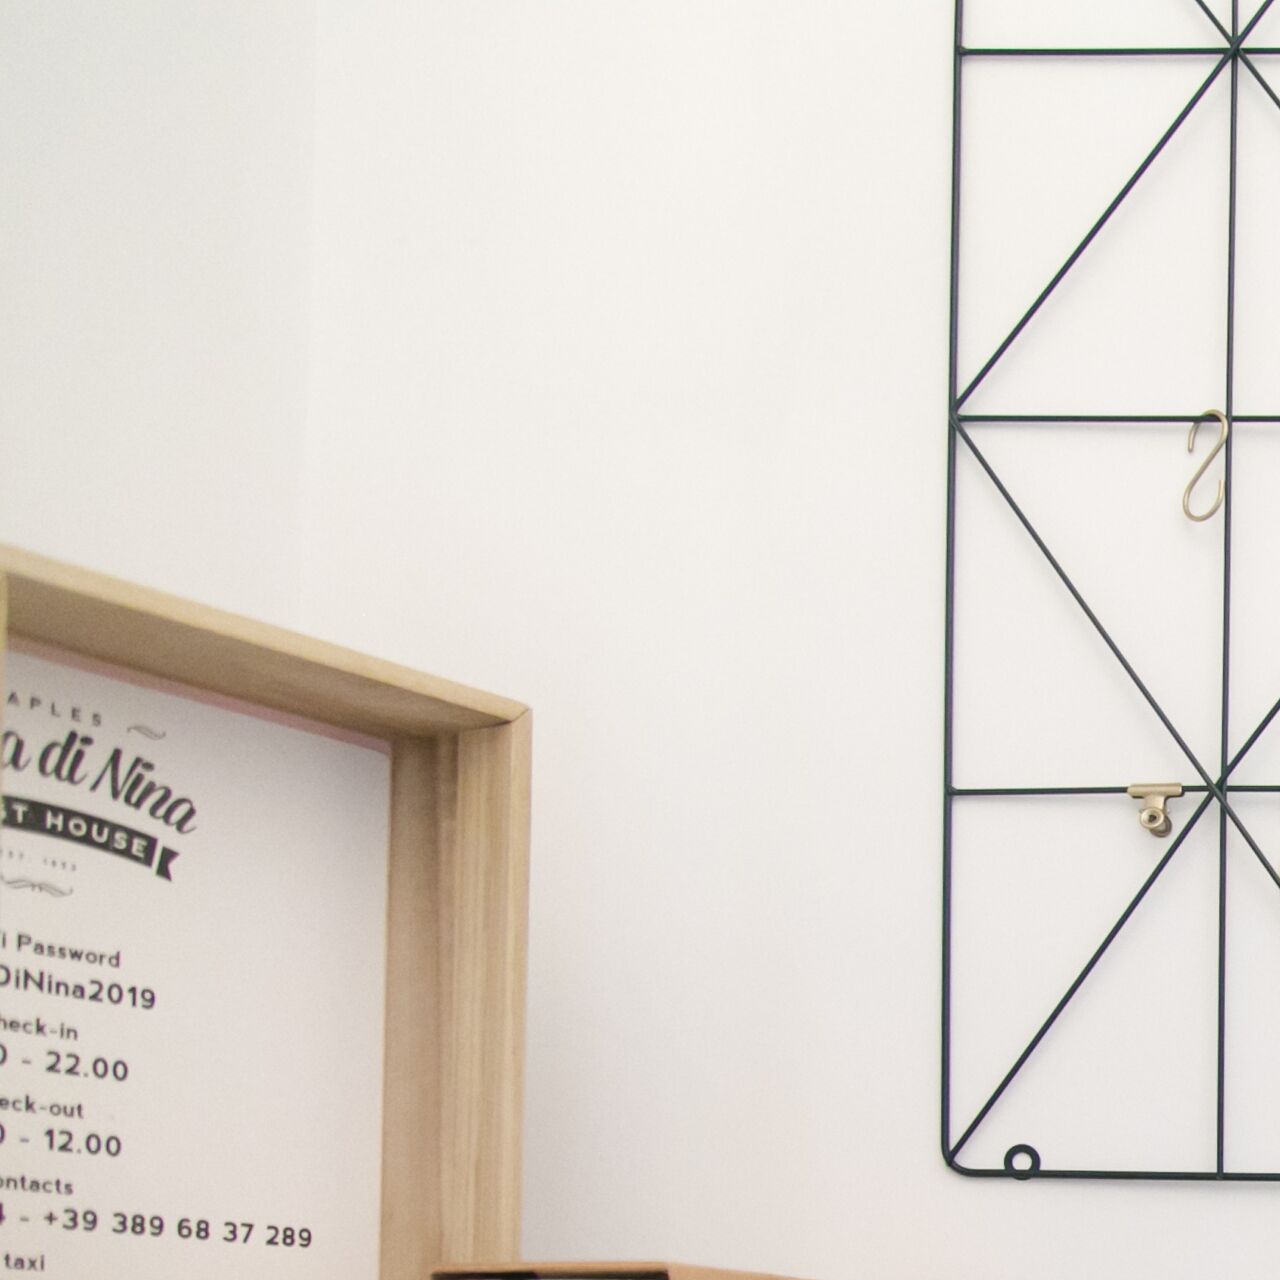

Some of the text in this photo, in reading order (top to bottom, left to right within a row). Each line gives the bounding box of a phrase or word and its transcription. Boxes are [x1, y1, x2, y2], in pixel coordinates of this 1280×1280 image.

[8, 692, 102, 728] APLES
[38, 730, 94, 785] di
[89, 747, 197, 834] Nina
[45, 808, 149, 859] HOUSE
[17, 933, 121, 968] Password
[0, 964, 156, 1010] DiNina2019
[45, 1050, 129, 1083] 22.00
[0, 1094, 84, 1119] eck-out
[43, 1128, 122, 1158] 12.00
[43, 1208, 98, 1231] +39
[111, 1212, 165, 1237] 389
[176, 1217, 211, 1241] 68
[222, 1221, 255, 1244] 37
[266, 1224, 313, 1248] 289
[4, 1252, 45, 1272] taxi
